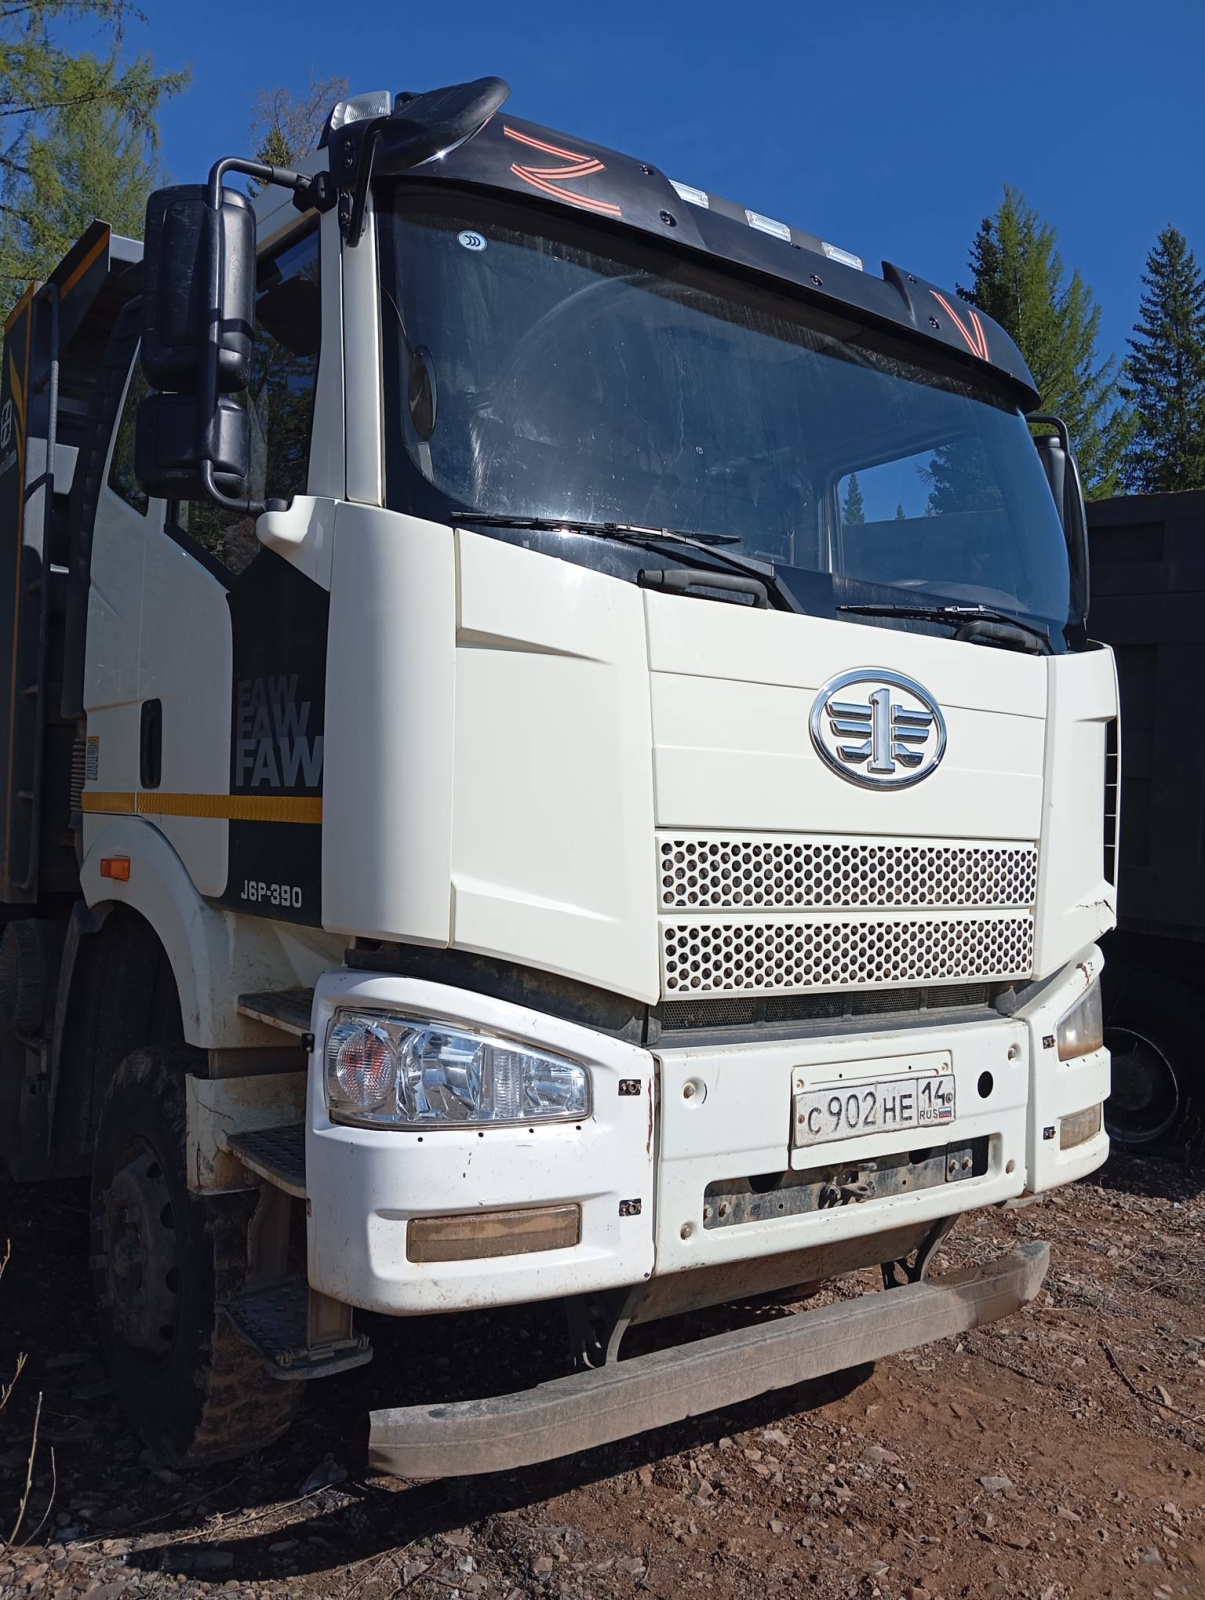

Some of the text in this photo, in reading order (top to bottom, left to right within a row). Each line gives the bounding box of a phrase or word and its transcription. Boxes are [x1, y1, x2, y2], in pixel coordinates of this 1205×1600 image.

[235, 735, 324, 787] FAW
[241, 879, 302, 908] J6P-390
[921, 1079, 947, 1107] 14
[919, 1108, 939, 1121] RUS
